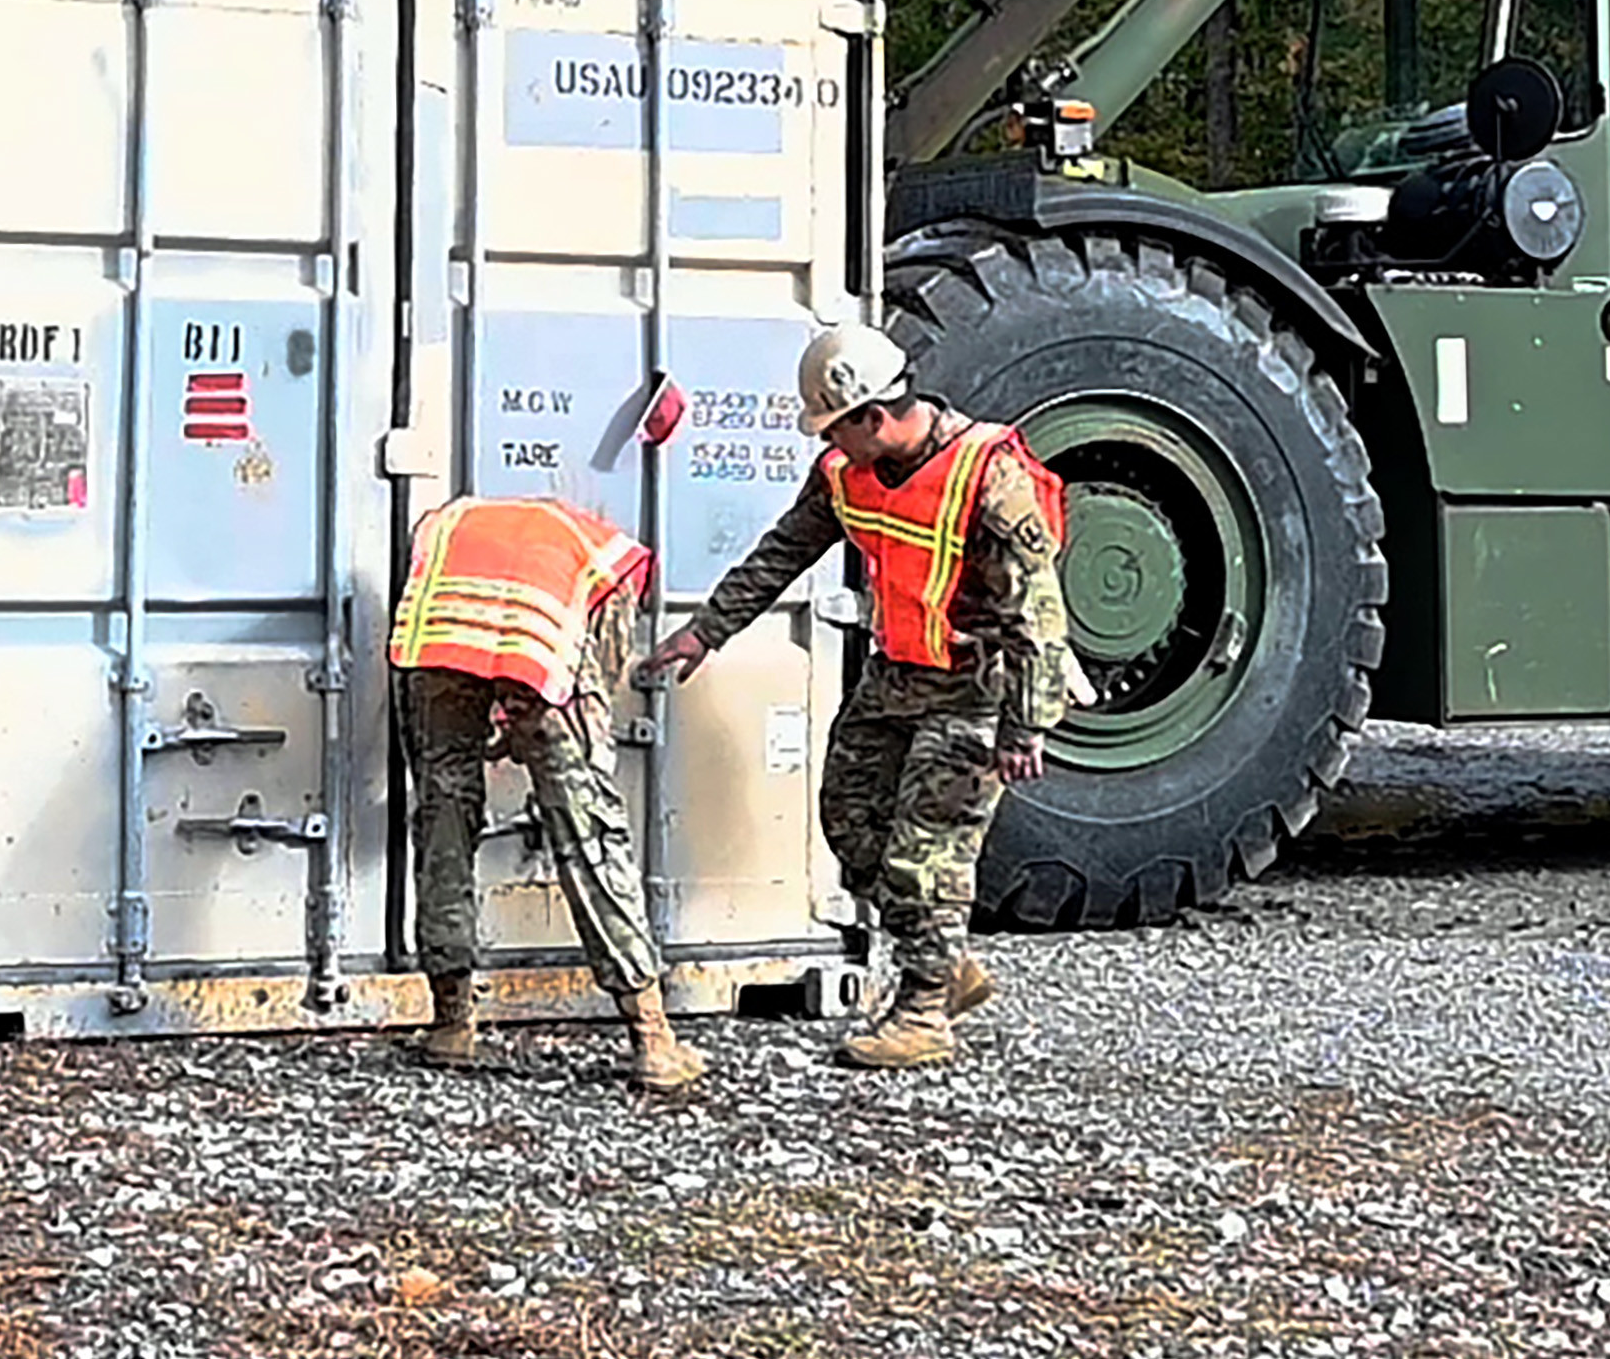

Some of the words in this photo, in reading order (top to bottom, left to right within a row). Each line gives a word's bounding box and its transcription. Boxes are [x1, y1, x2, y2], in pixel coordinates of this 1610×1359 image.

[555, 60, 647, 98] USAU
[667, 68, 803, 108] 092334
[817, 78, 839, 108] 0
[501, 442, 560, 467] TARE
